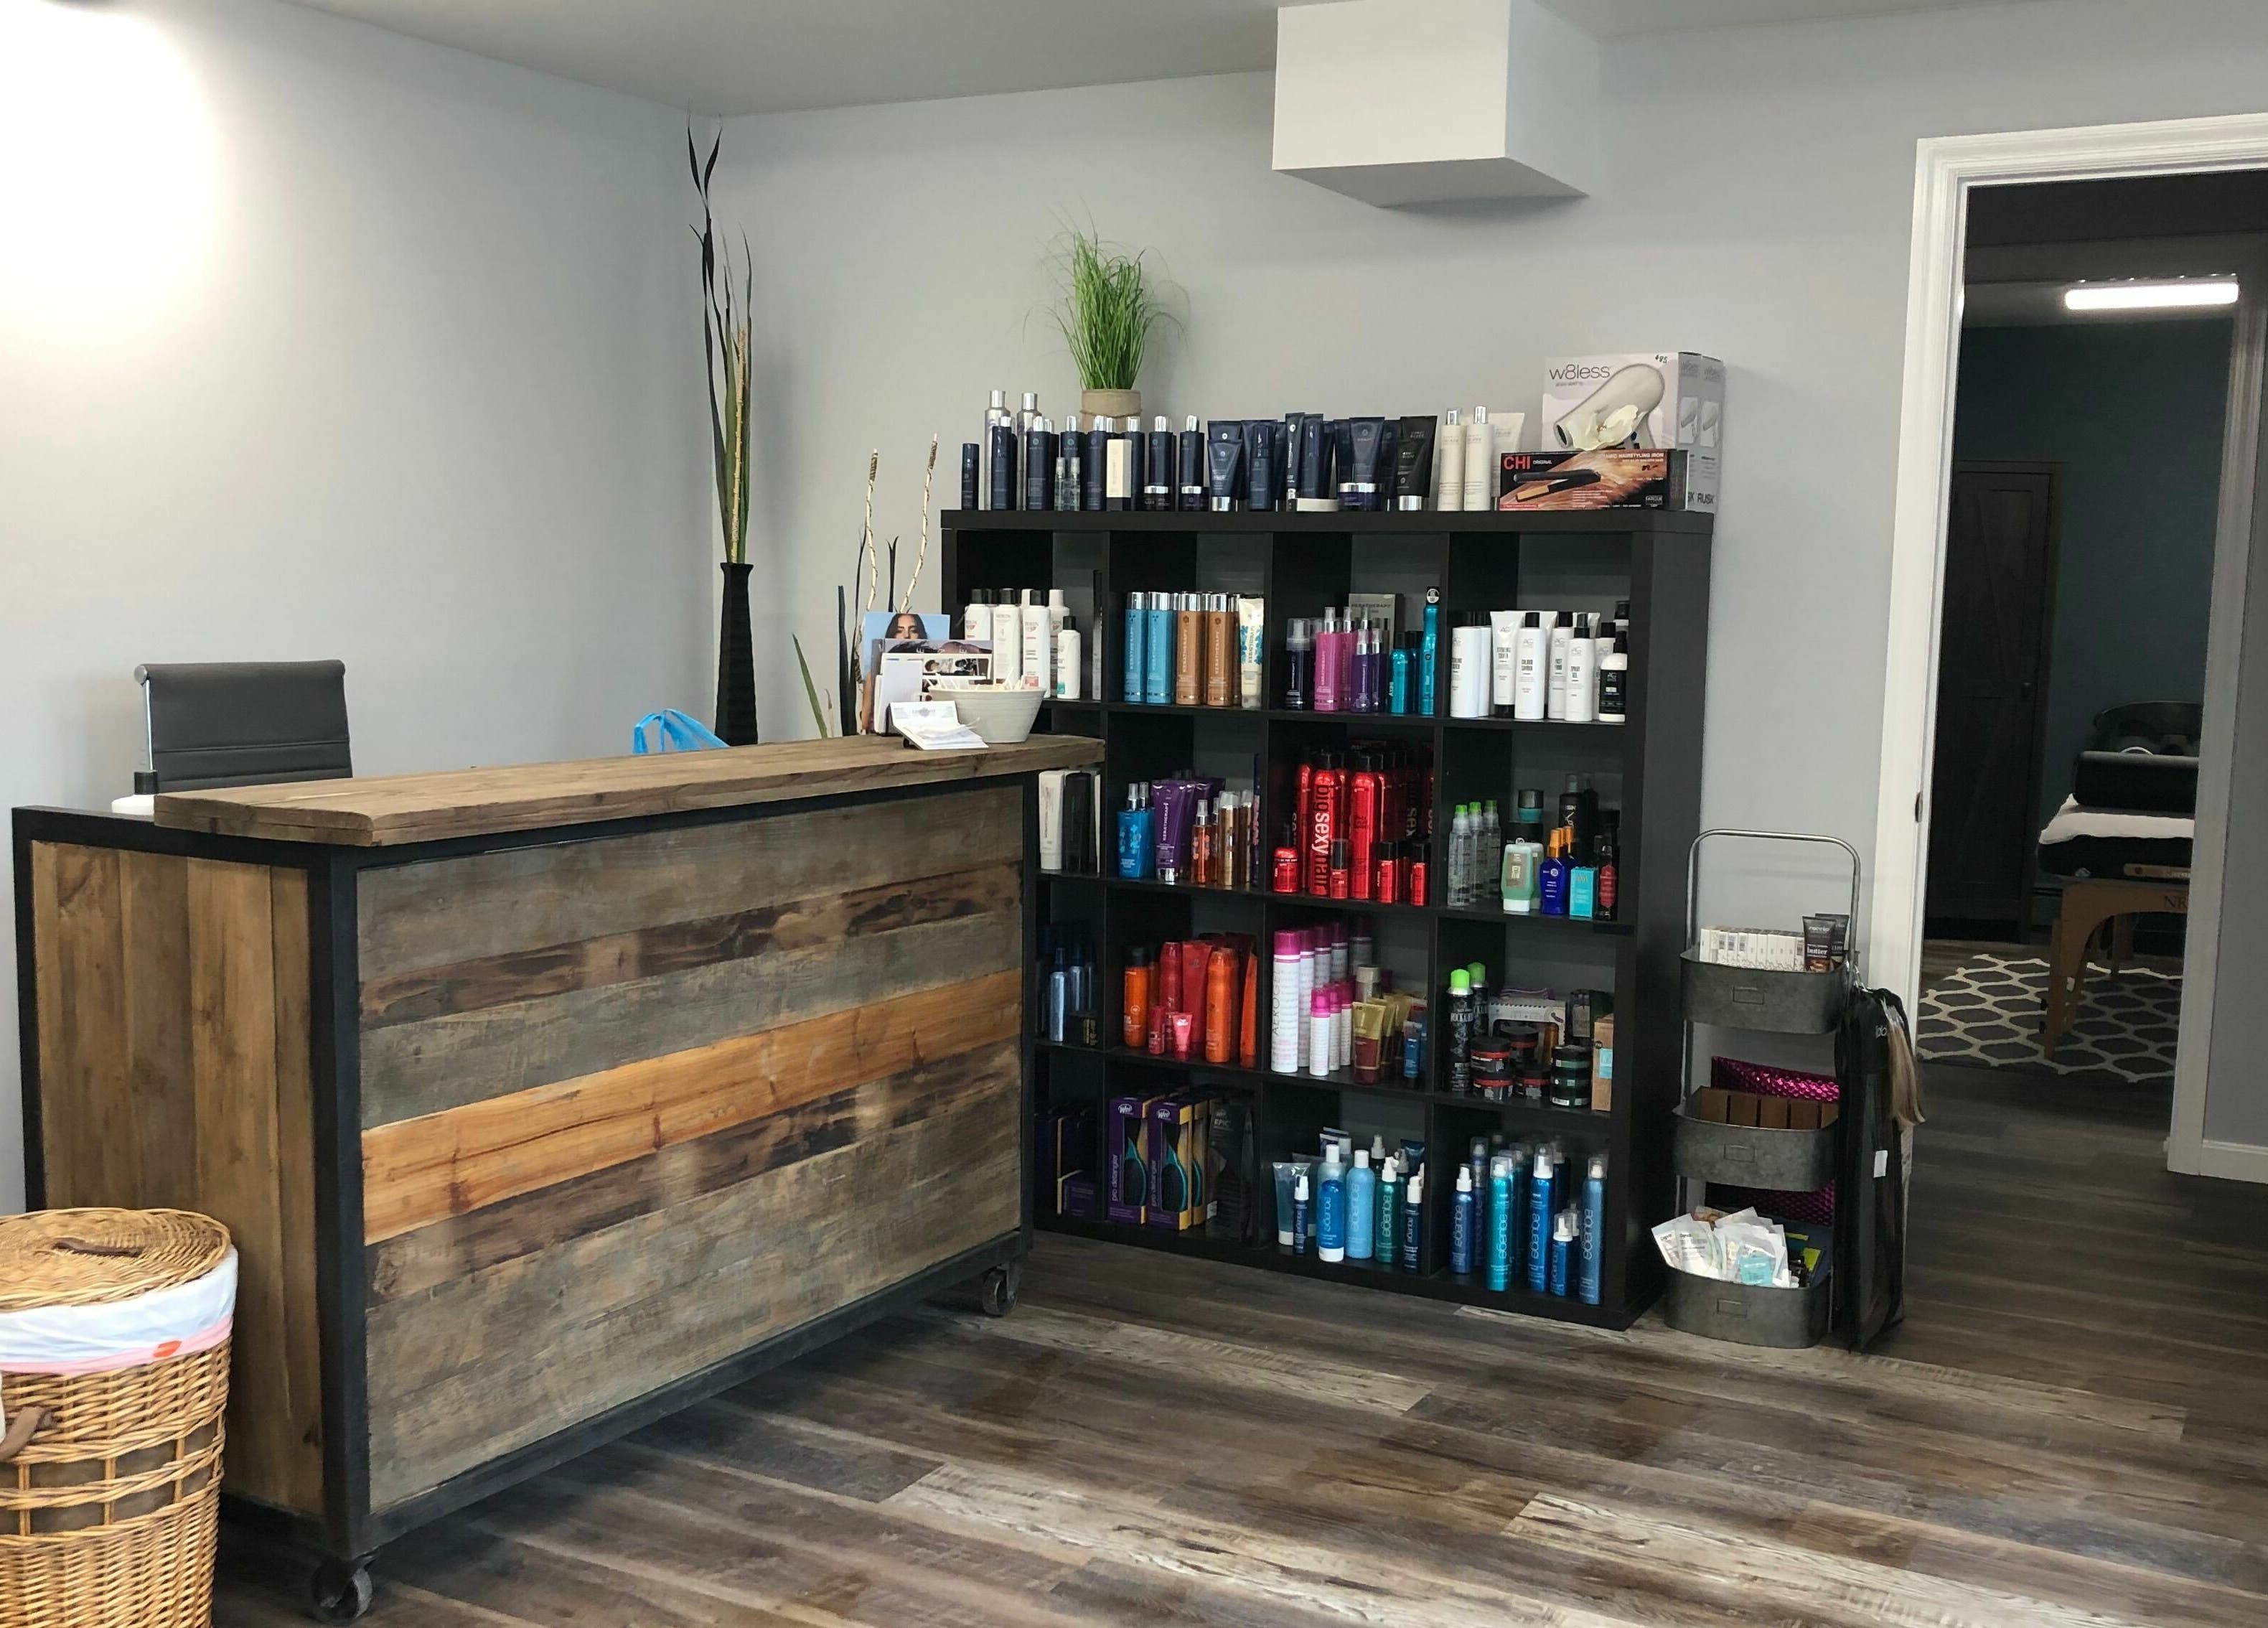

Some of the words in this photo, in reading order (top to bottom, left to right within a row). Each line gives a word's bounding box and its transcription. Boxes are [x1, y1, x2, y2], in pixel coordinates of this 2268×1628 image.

[1549, 362, 1611, 380] w8less
[1504, 455, 1531, 470] CHI
[1697, 492, 1715, 505] RUSK
[2164, 895, 2188, 909] NR
[1807, 946, 1828, 955] butter
